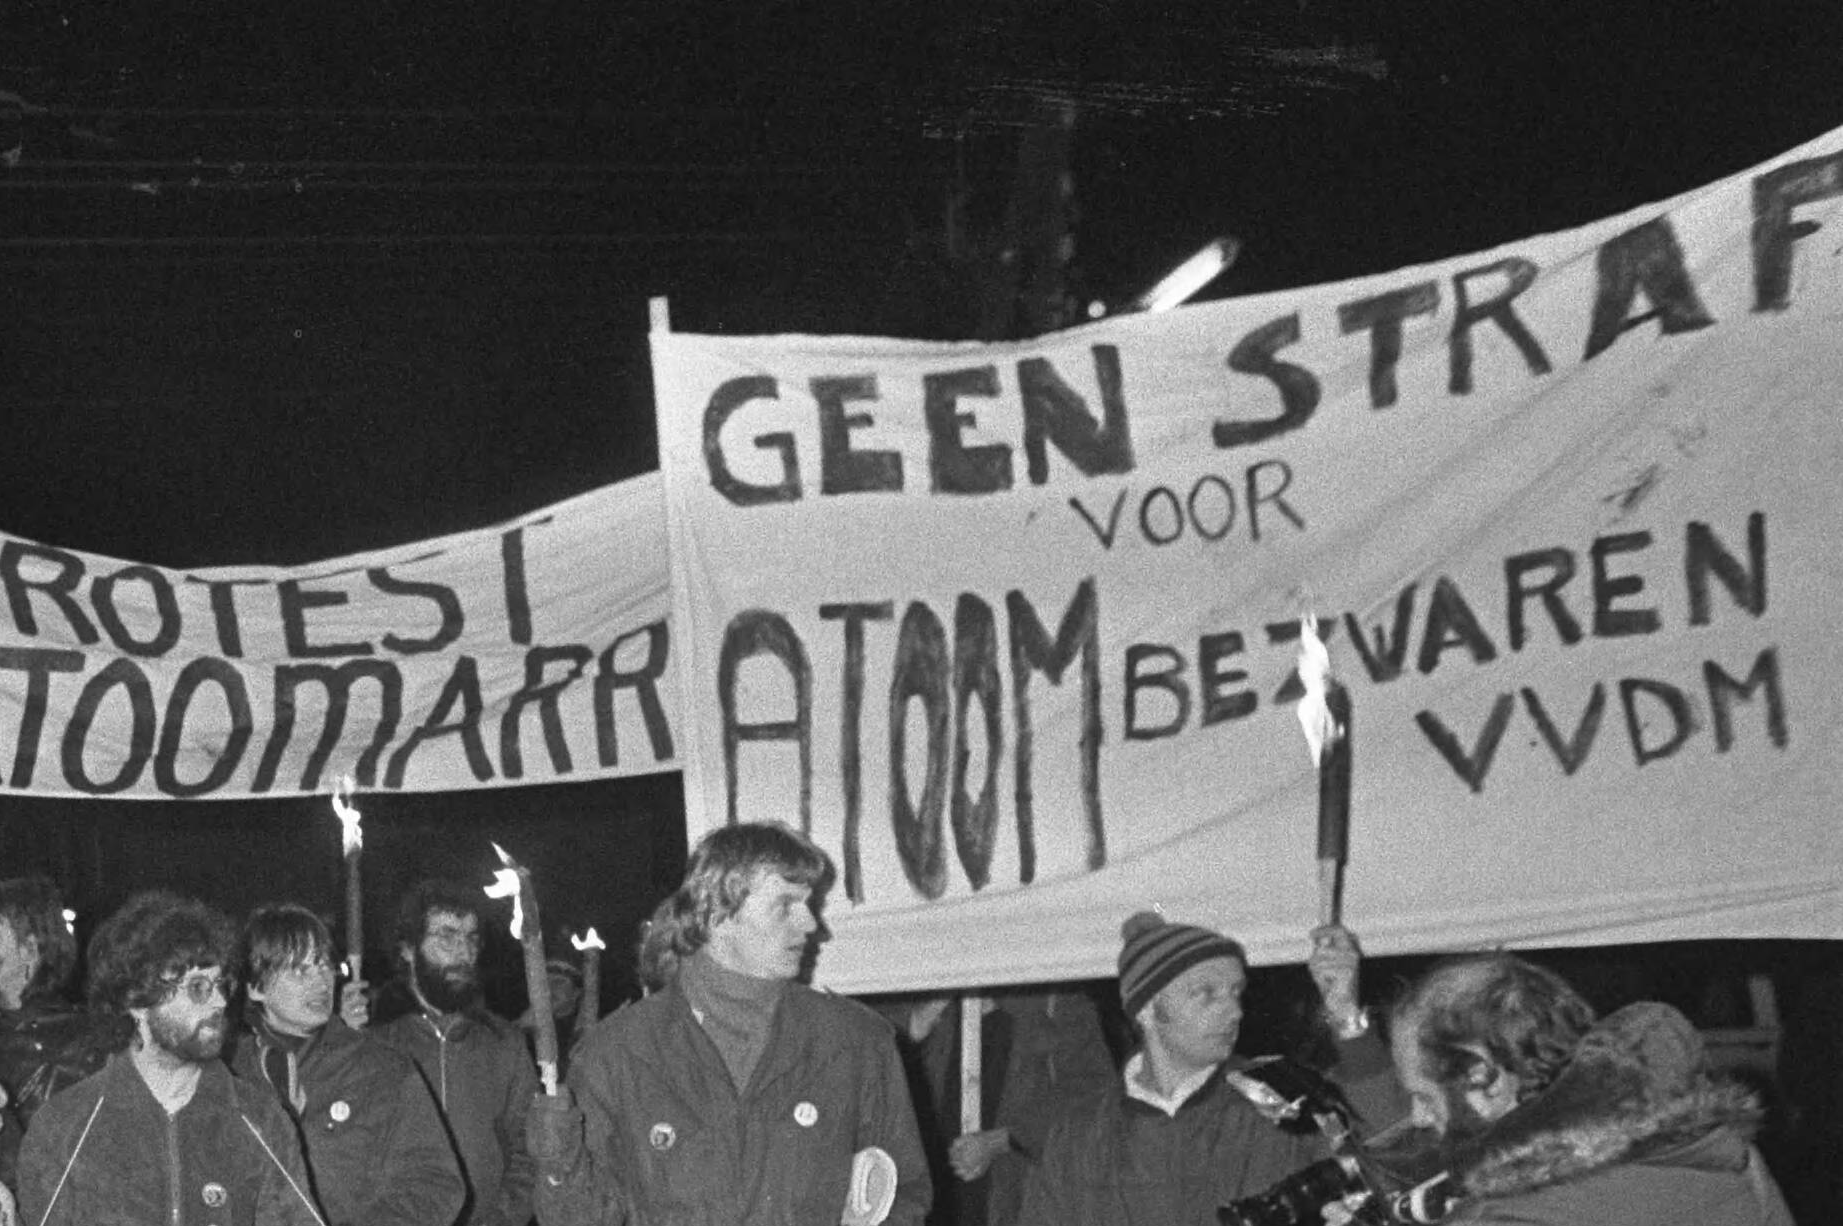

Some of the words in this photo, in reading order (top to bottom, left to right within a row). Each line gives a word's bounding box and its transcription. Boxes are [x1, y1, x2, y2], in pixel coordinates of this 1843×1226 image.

[703, 343, 1137, 508] GEEN
[1068, 460, 1305, 550] VOOR
[718, 576, 1106, 906] ATOOM
[1415, 645, 1788, 793] VVDM
